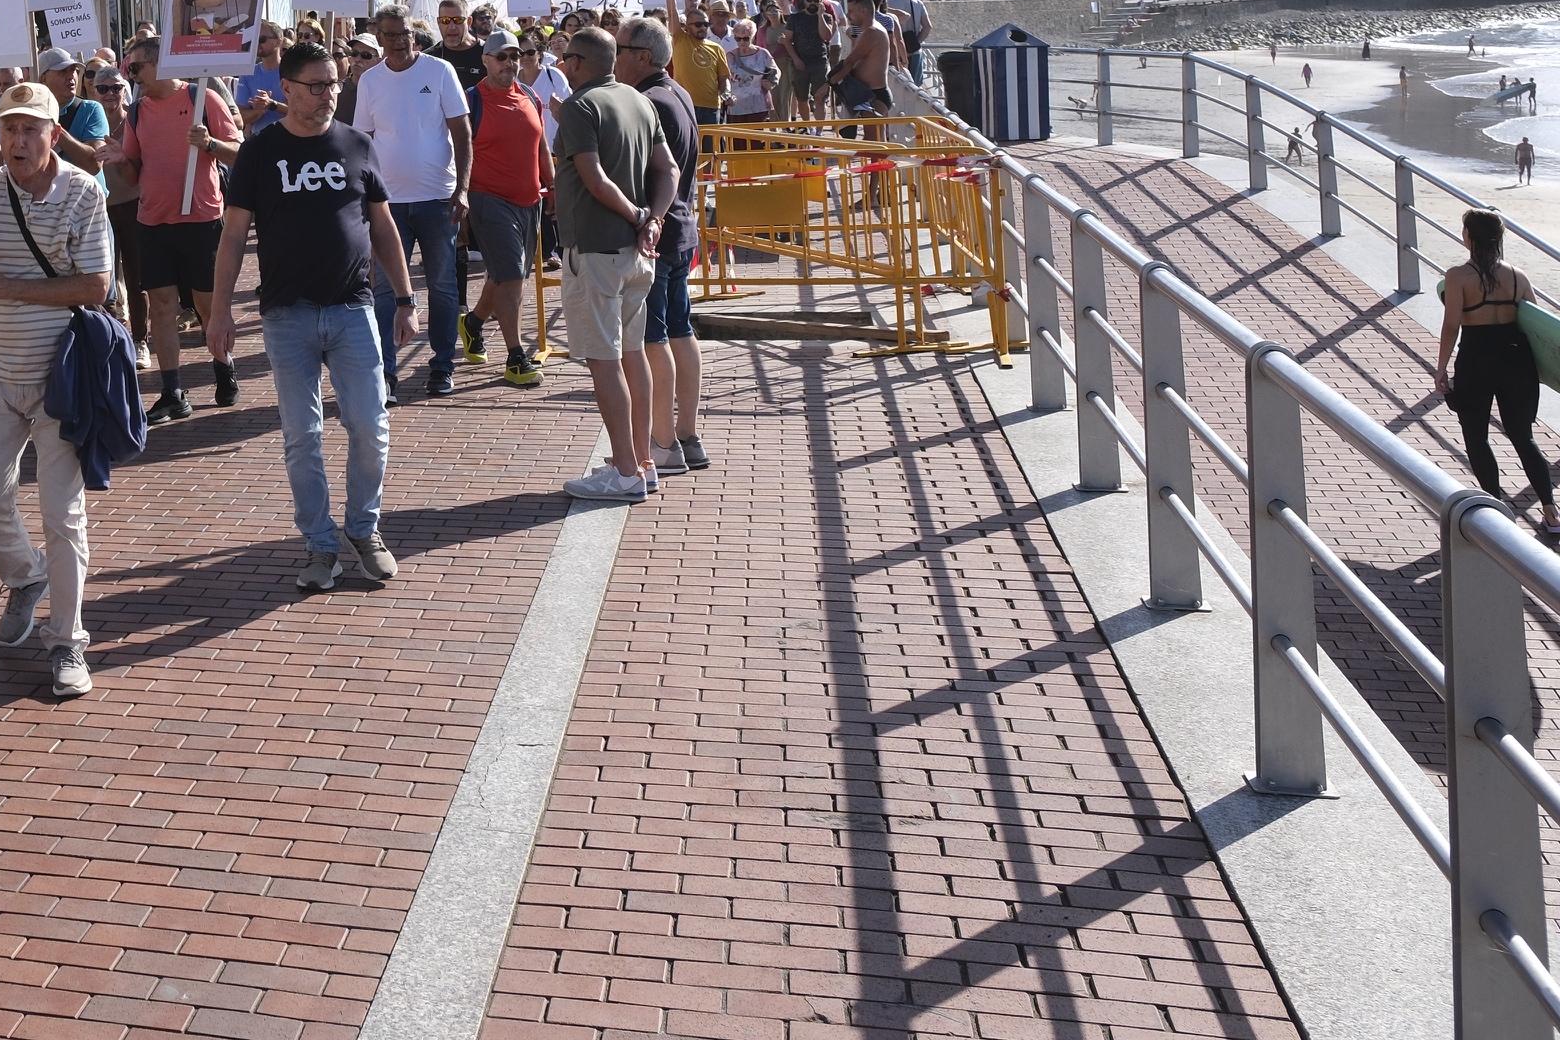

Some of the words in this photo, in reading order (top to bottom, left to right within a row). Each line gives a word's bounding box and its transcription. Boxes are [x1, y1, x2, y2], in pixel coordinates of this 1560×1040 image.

[50, 17, 74, 26] SOMOS
[76, 13, 92, 22] MÁS
[61, 28, 82, 42] LPGC
[277, 159, 347, 193] Lee
